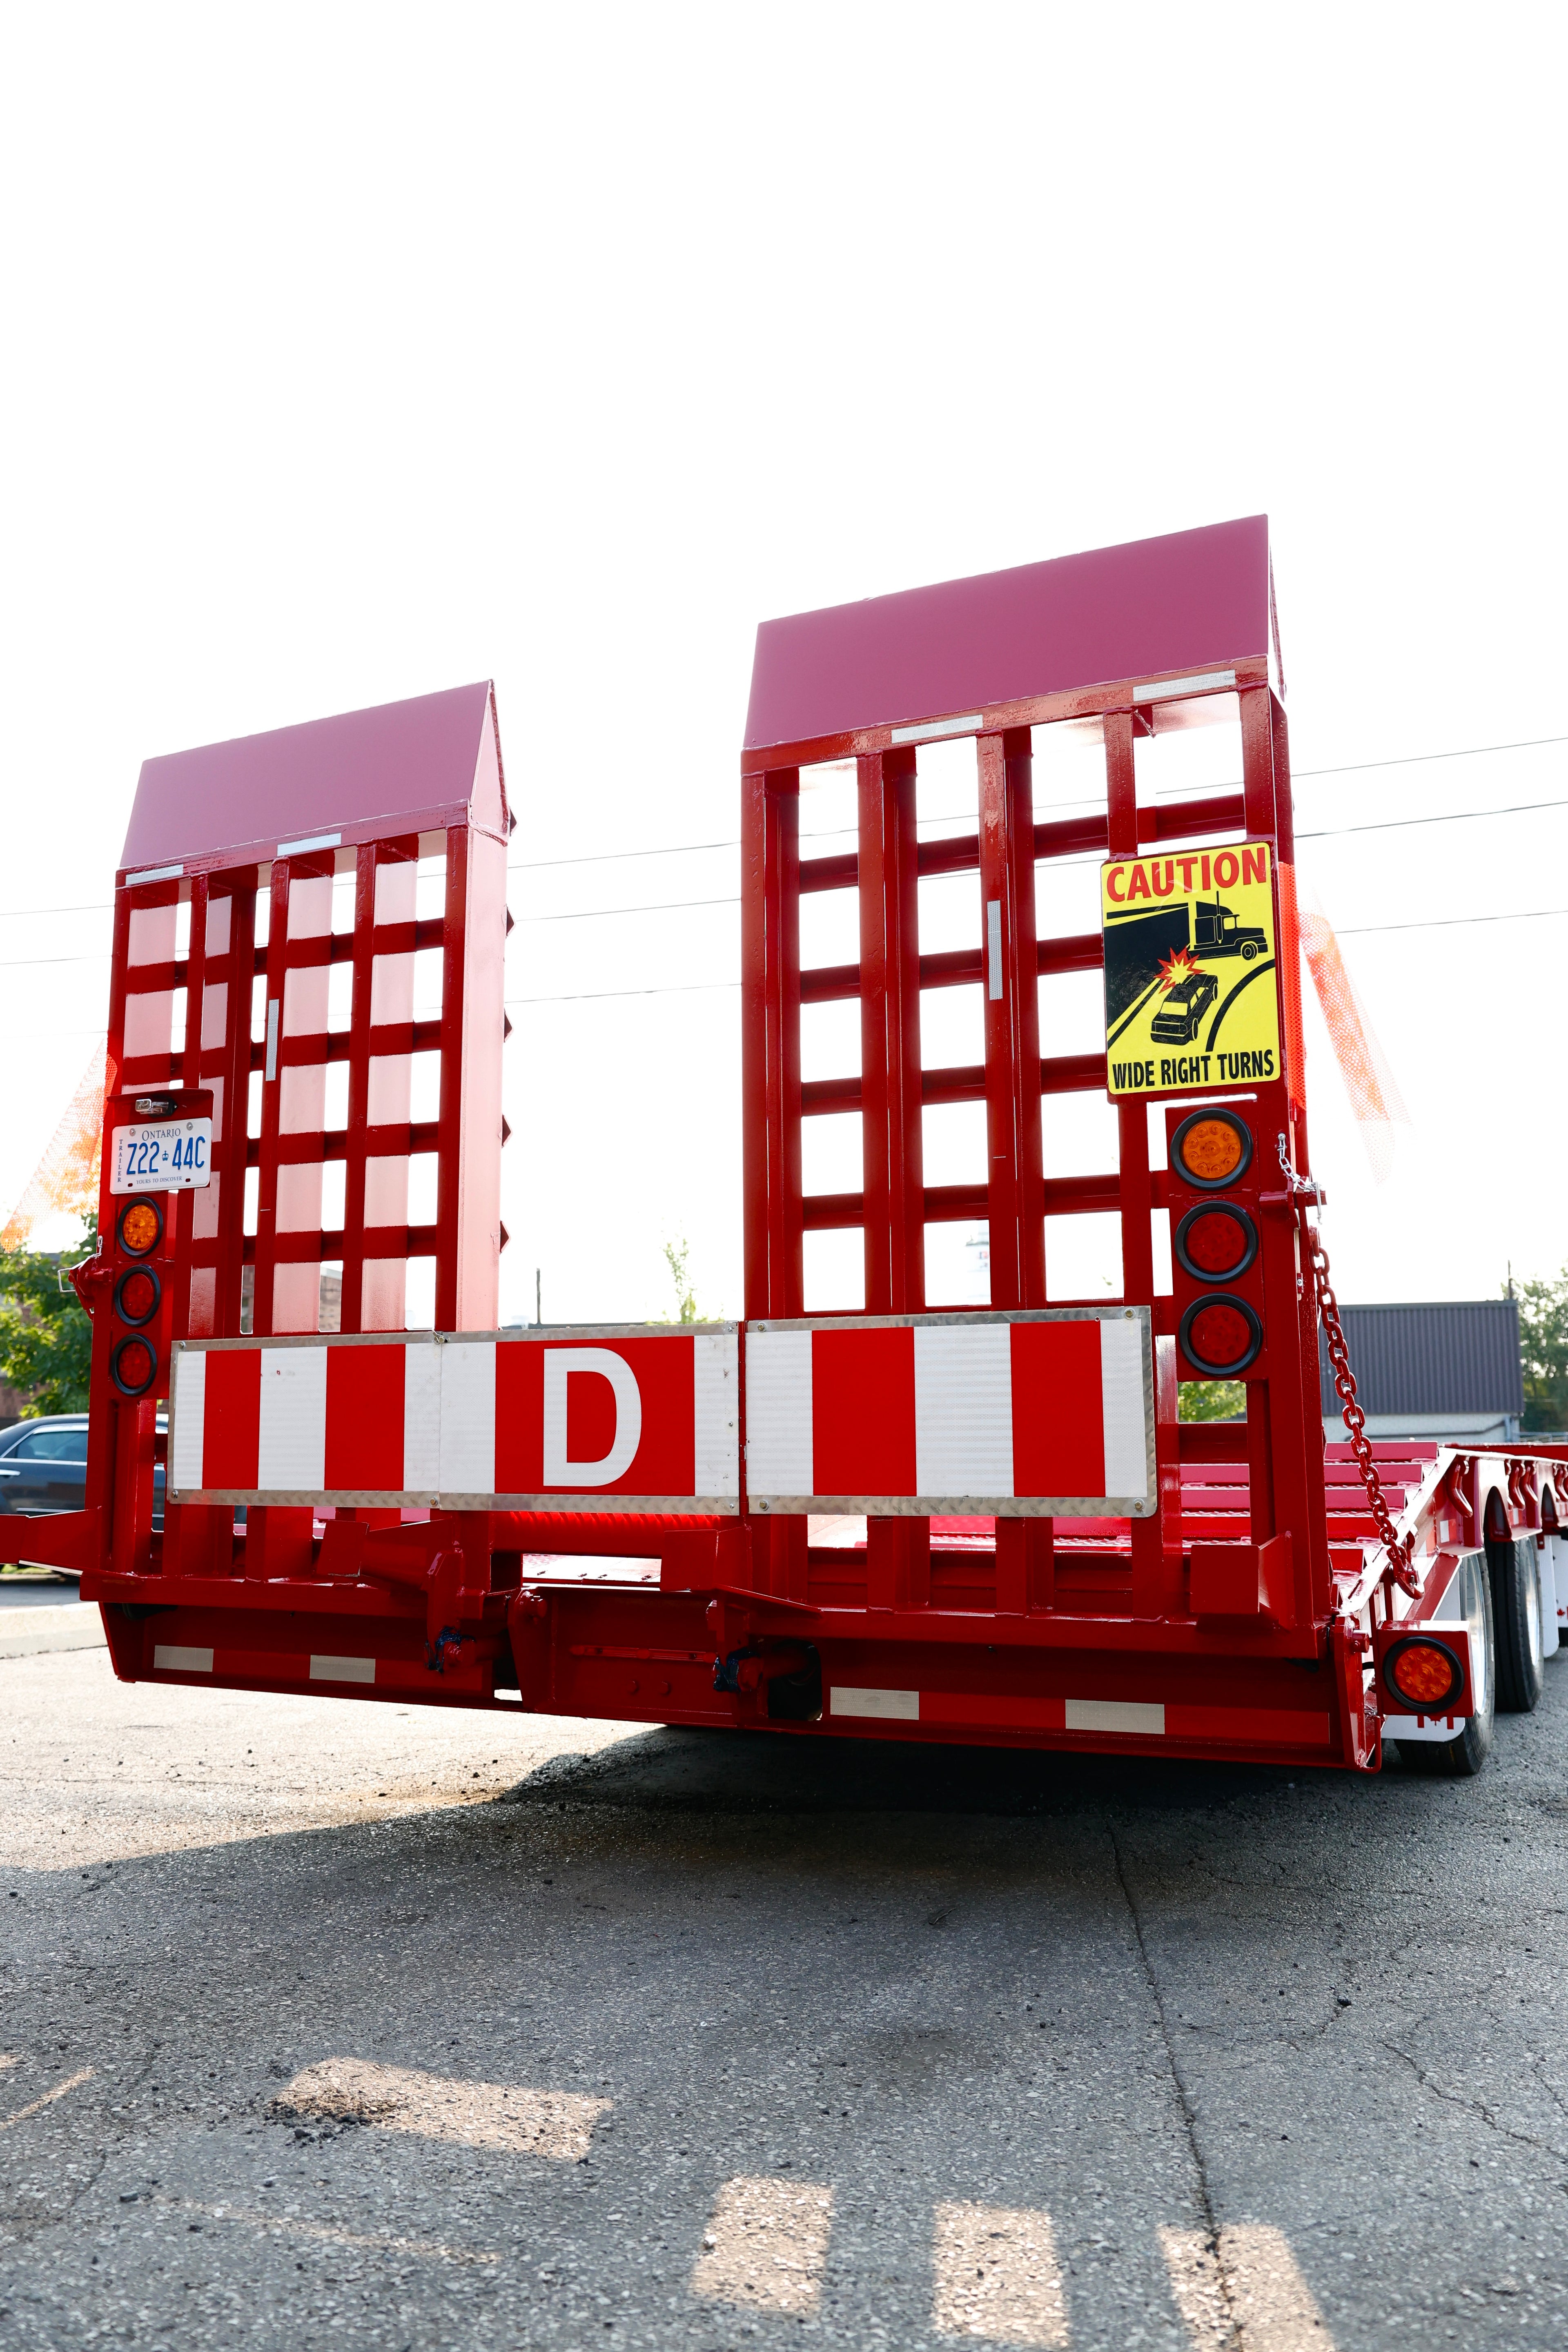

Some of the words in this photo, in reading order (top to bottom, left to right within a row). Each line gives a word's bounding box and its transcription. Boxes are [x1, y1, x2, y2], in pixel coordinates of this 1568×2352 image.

[1107, 847, 1266, 902] CAUTION
[1112, 1060, 1155, 1089] WIDE
[1160, 1055, 1211, 1085] RIGHT
[1217, 1049, 1274, 1080] TURNS
[142, 1128, 181, 1141] ONTARIO
[126, 1141, 160, 1175] Z22
[172, 1136, 206, 1170] 44C
[543, 1347, 642, 1487] D
